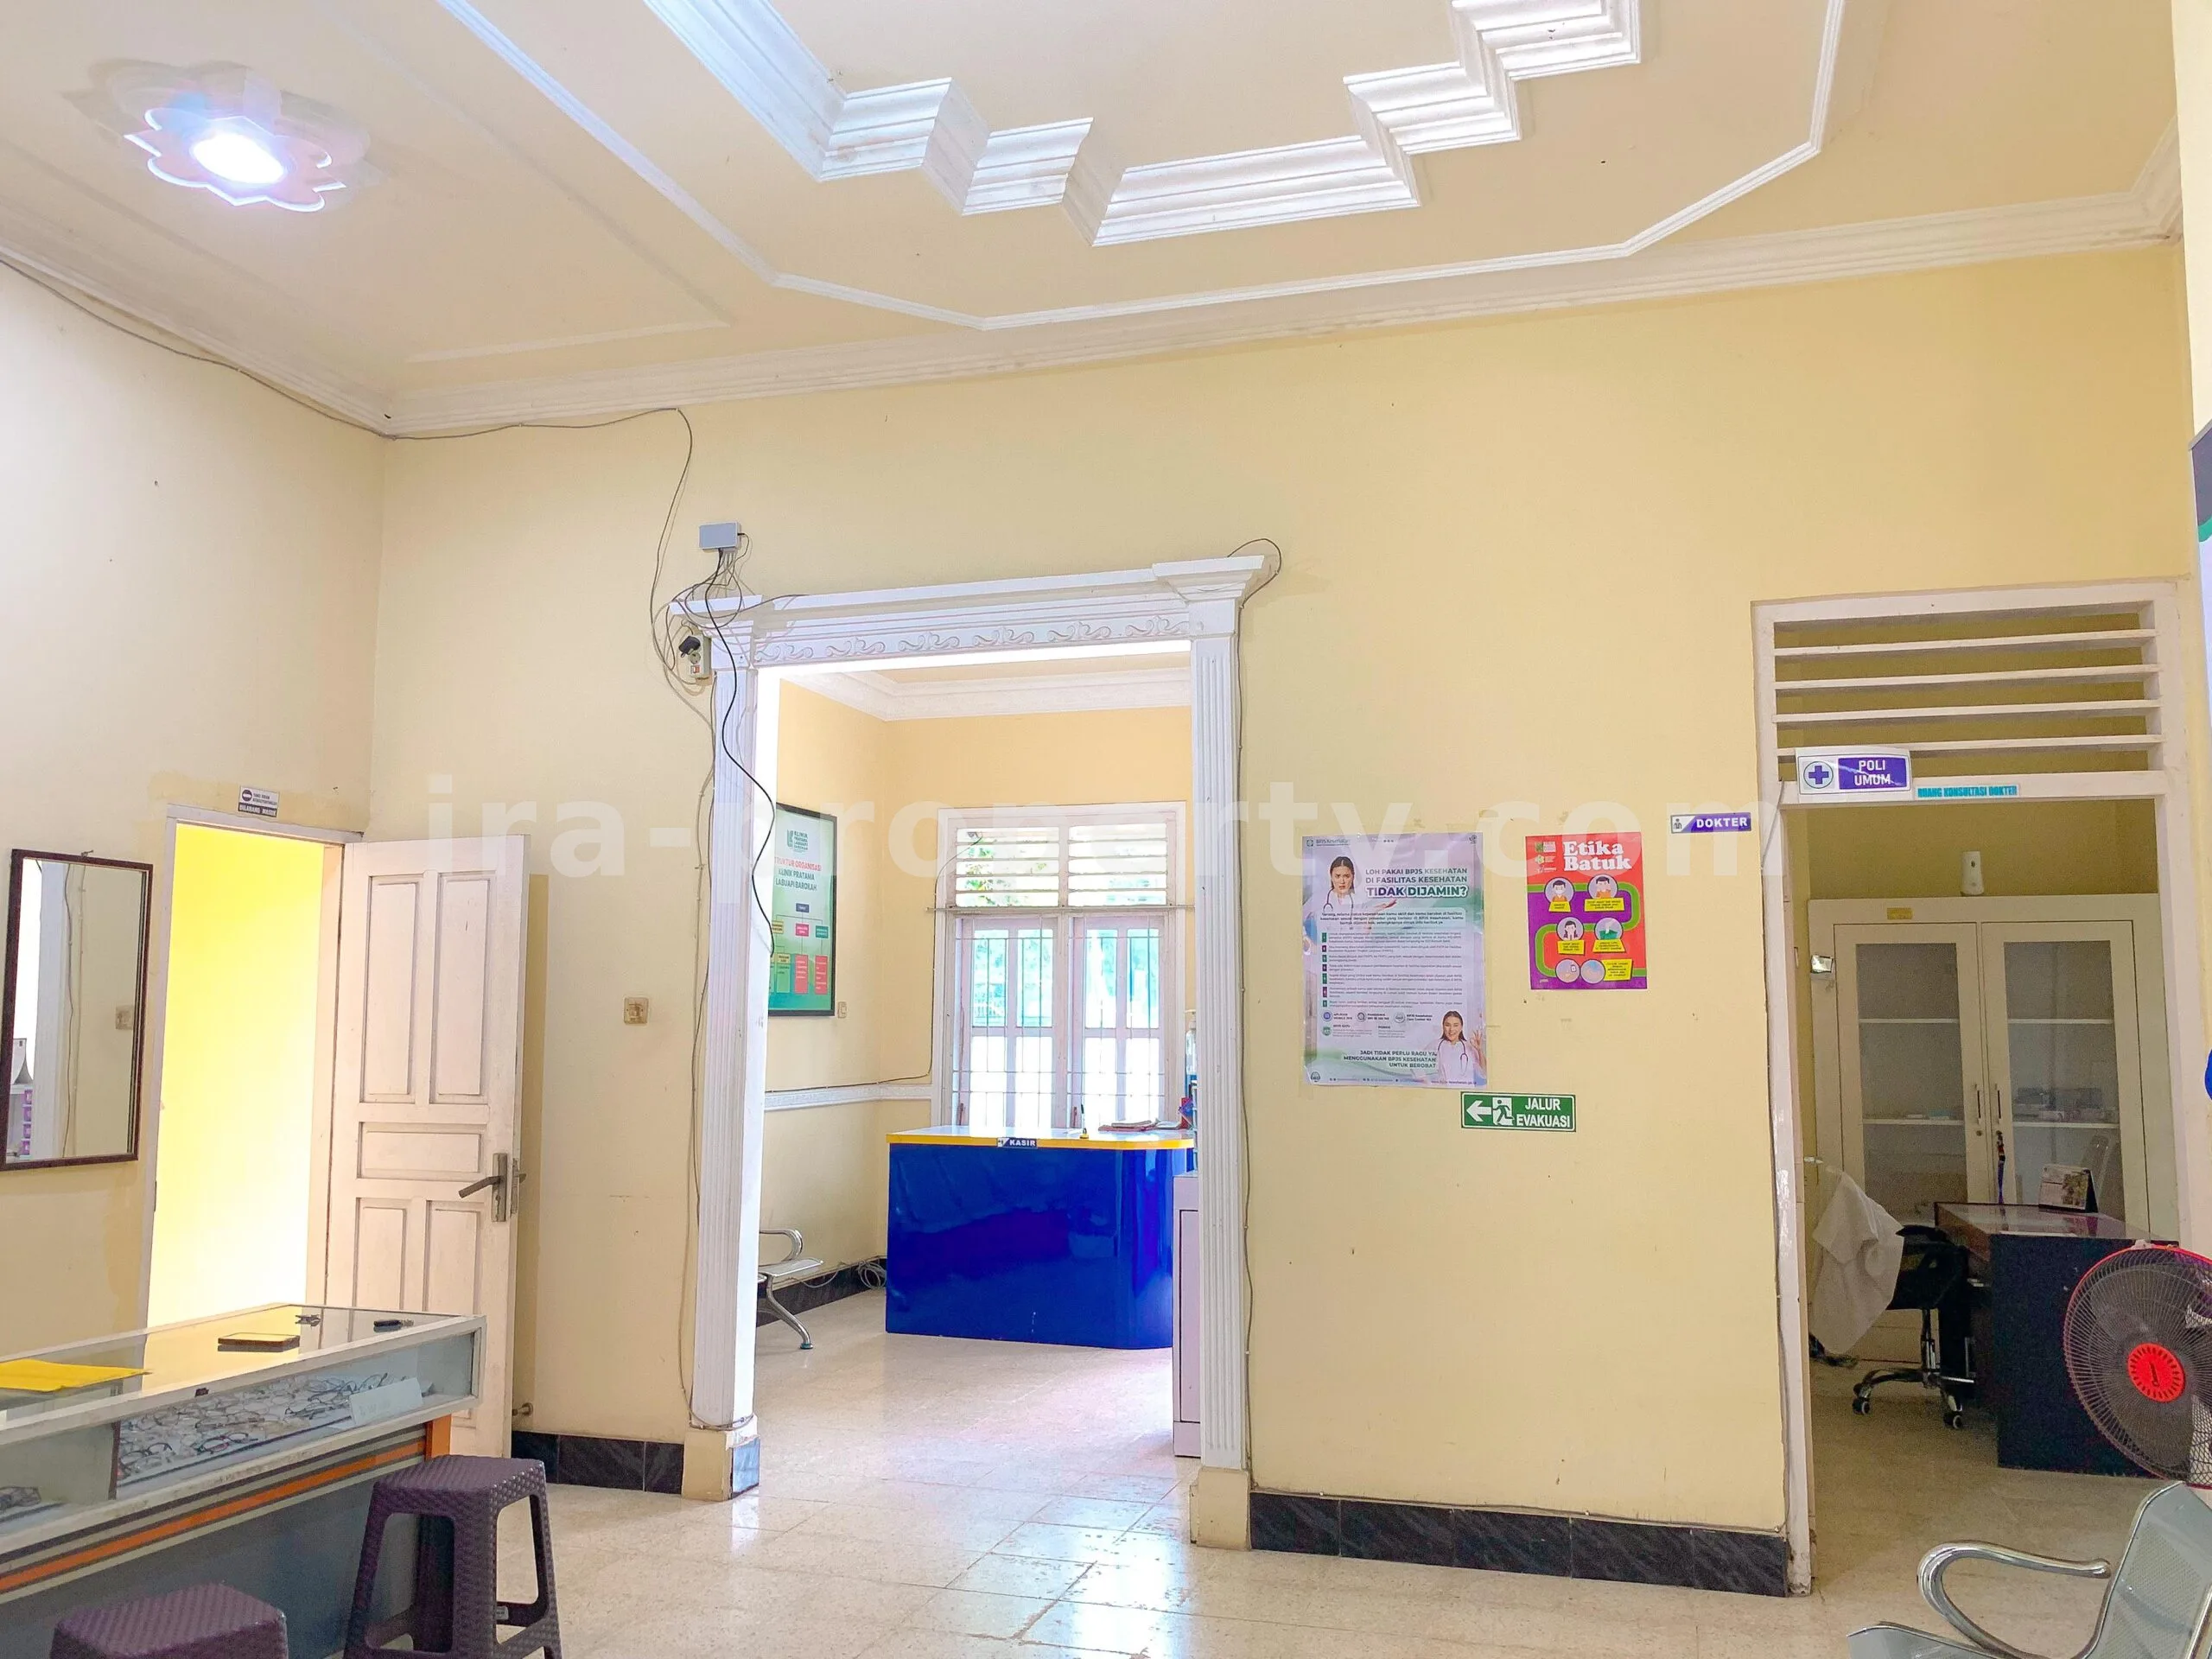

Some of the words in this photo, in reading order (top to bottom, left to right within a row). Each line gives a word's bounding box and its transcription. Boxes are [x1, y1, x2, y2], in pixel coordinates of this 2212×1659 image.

[1859, 760, 1886, 772] POLI
[1854, 773, 1891, 785] UMUM
[1696, 817, 1747, 828] DOKTER
[1563, 841, 1624, 856] Etika
[1564, 855, 1631, 871] Batuk
[793, 870, 815, 880] PRATAMA
[1366, 887, 1404, 896] TIDAK
[1408, 886, 1467, 896] DIJAMIN?
[1525, 1097, 1560, 1110] JALUR
[1516, 1114, 1571, 1128] EVAKUASI
